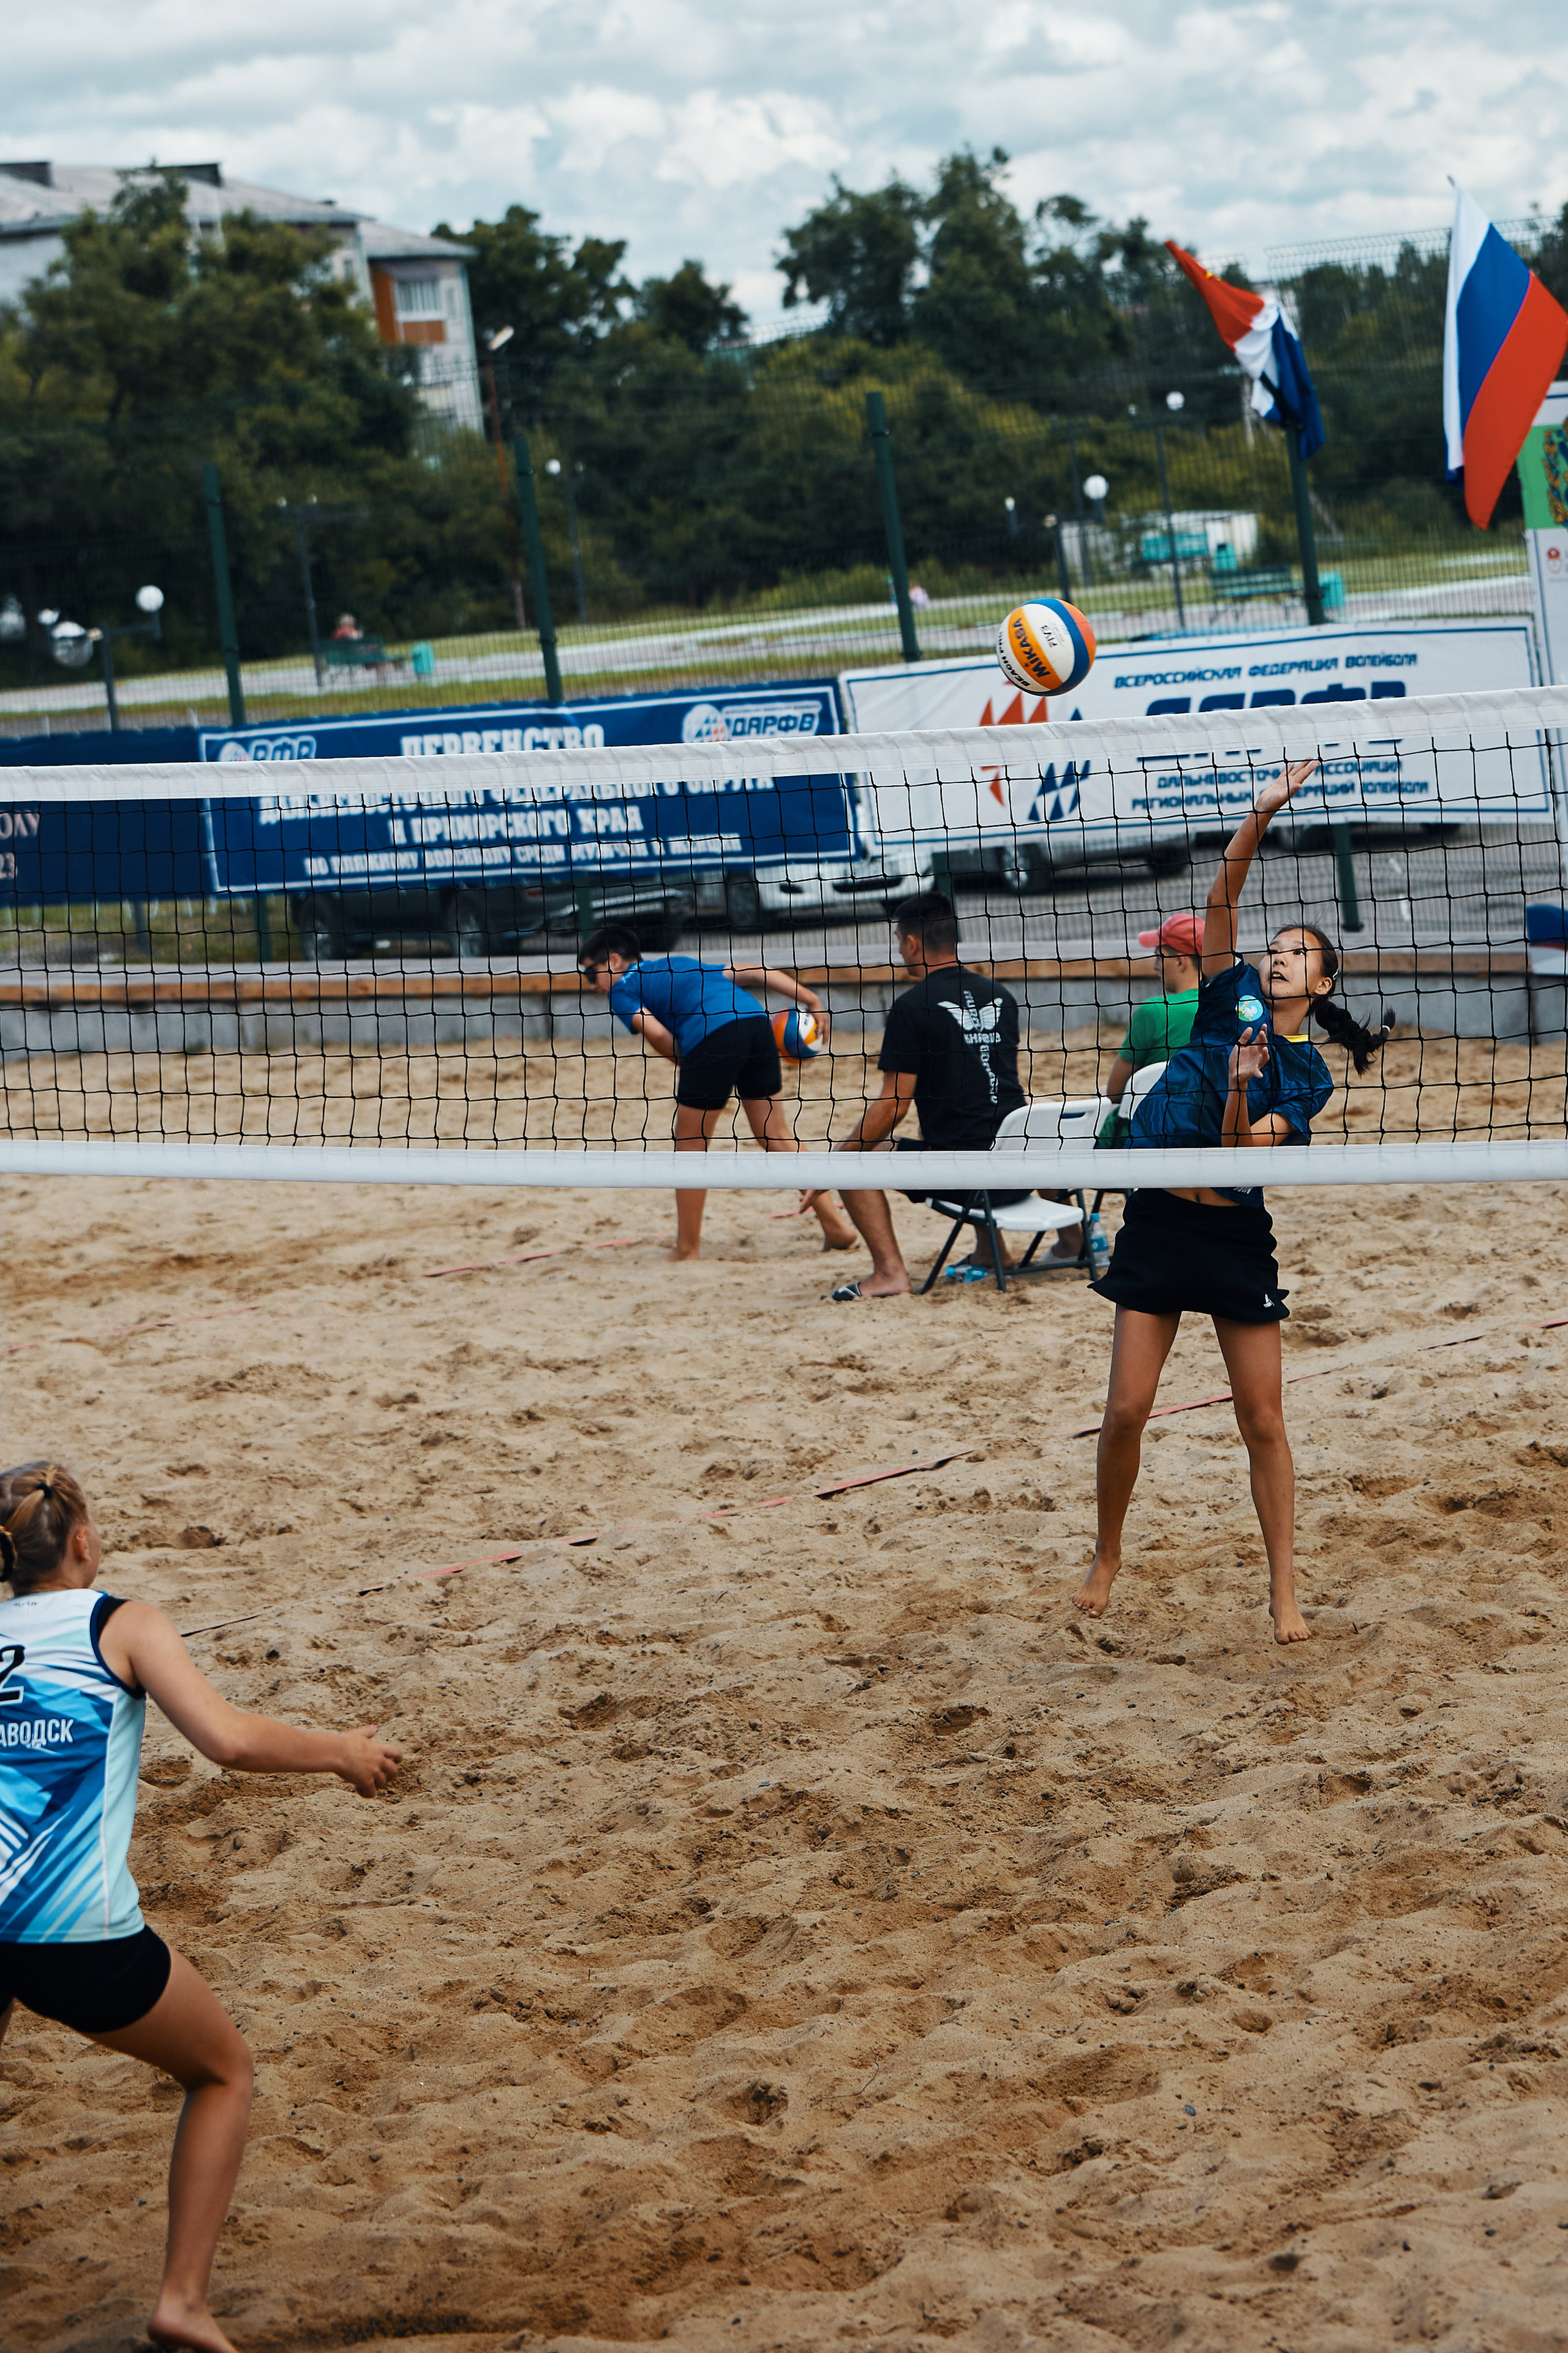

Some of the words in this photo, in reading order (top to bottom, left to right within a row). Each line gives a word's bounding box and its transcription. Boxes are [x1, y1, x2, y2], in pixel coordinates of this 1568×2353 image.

[1013, 618, 1051, 678] MIKASA
[1002, 656, 1031, 687] BEACH
[1114, 667, 1242, 689] ВСЕРОССИЙСКАЯ
[1248, 657, 1339, 677] ФЕДЕРАЦИЯ
[1344, 652, 1418, 669] ВОЛЕЙБОЛА
[410, 809, 571, 844] ПРИМОРСКОГО
[576, 806, 644, 834] КРАЯ
[0, 1644, 25, 1707] 2
